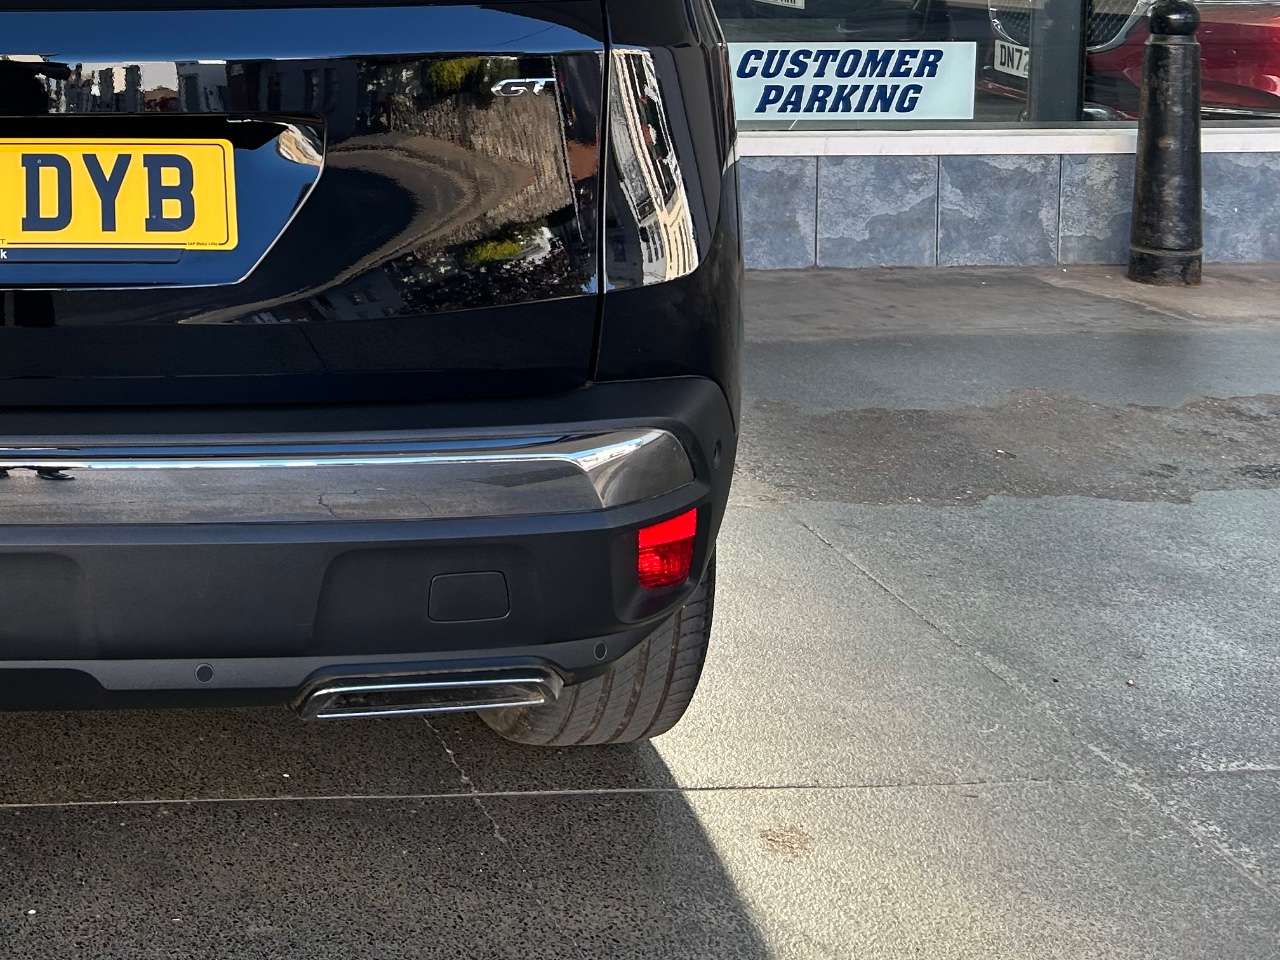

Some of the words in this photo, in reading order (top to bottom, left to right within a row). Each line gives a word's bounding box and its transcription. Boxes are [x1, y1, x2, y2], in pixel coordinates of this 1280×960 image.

[736, 49, 944, 78] CUSTOMER
[490, 77, 557, 97] GT
[754, 83, 923, 114] PARKING
[21, 153, 196, 233] DYB
